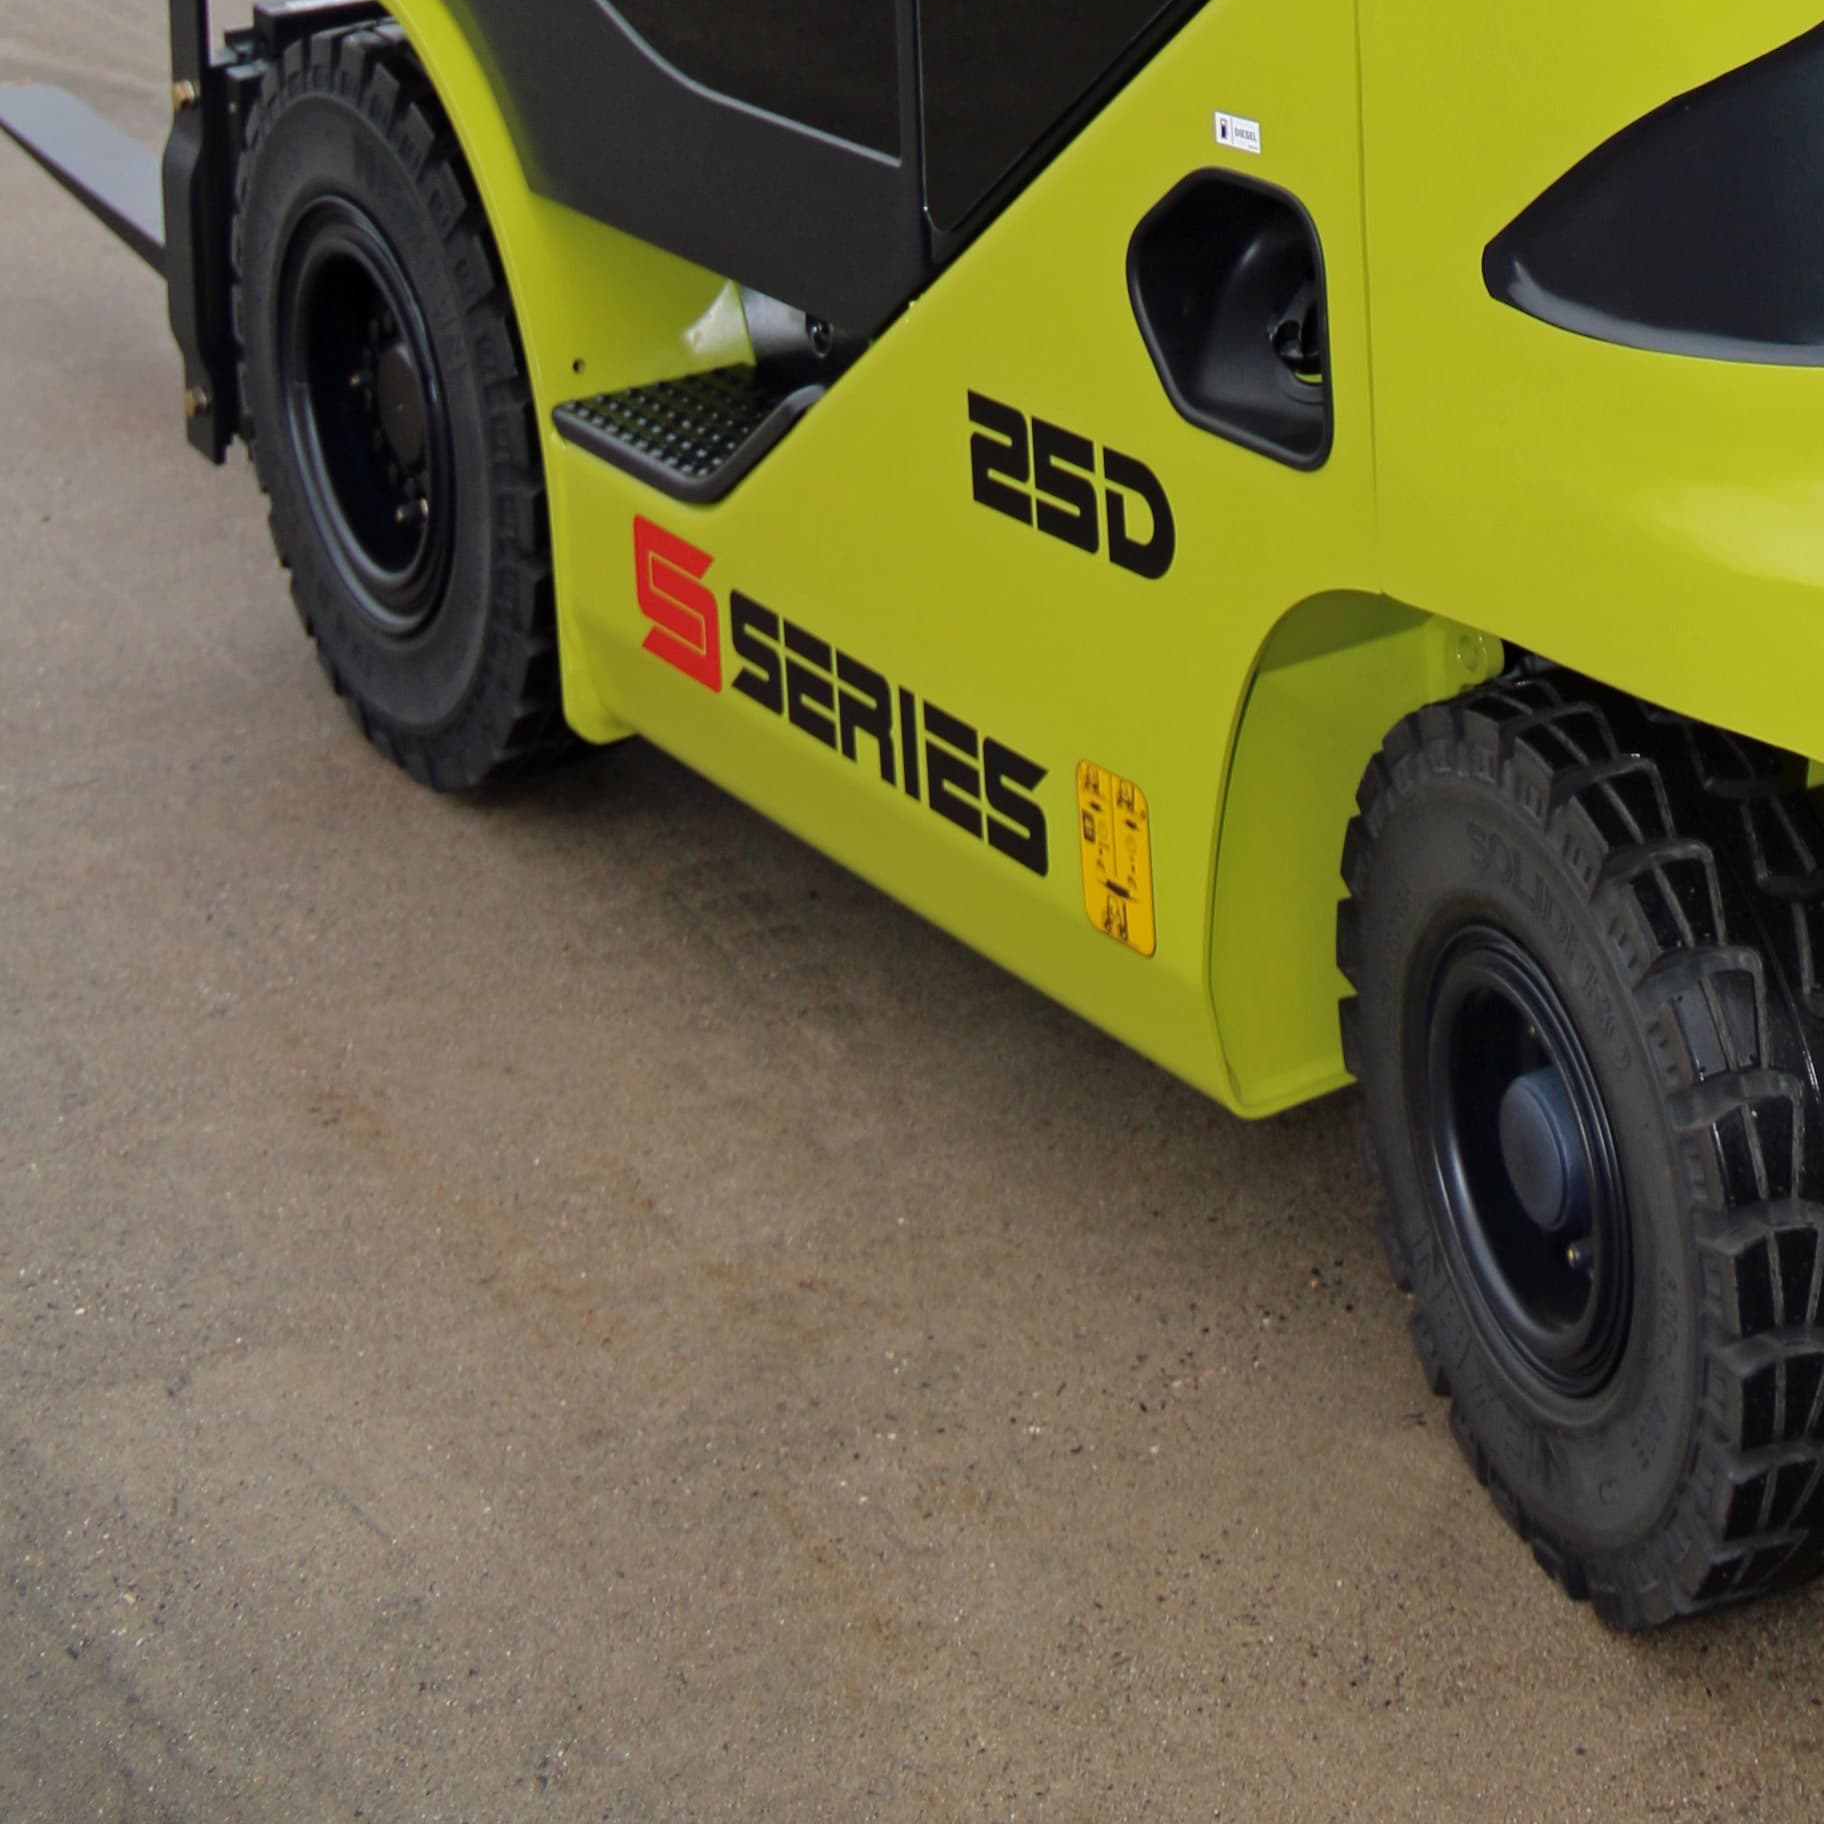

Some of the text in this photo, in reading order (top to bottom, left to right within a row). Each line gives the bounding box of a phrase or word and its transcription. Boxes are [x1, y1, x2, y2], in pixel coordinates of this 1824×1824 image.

[967, 388, 1176, 581] 25D
[633, 513, 1050, 878] S SERIES
